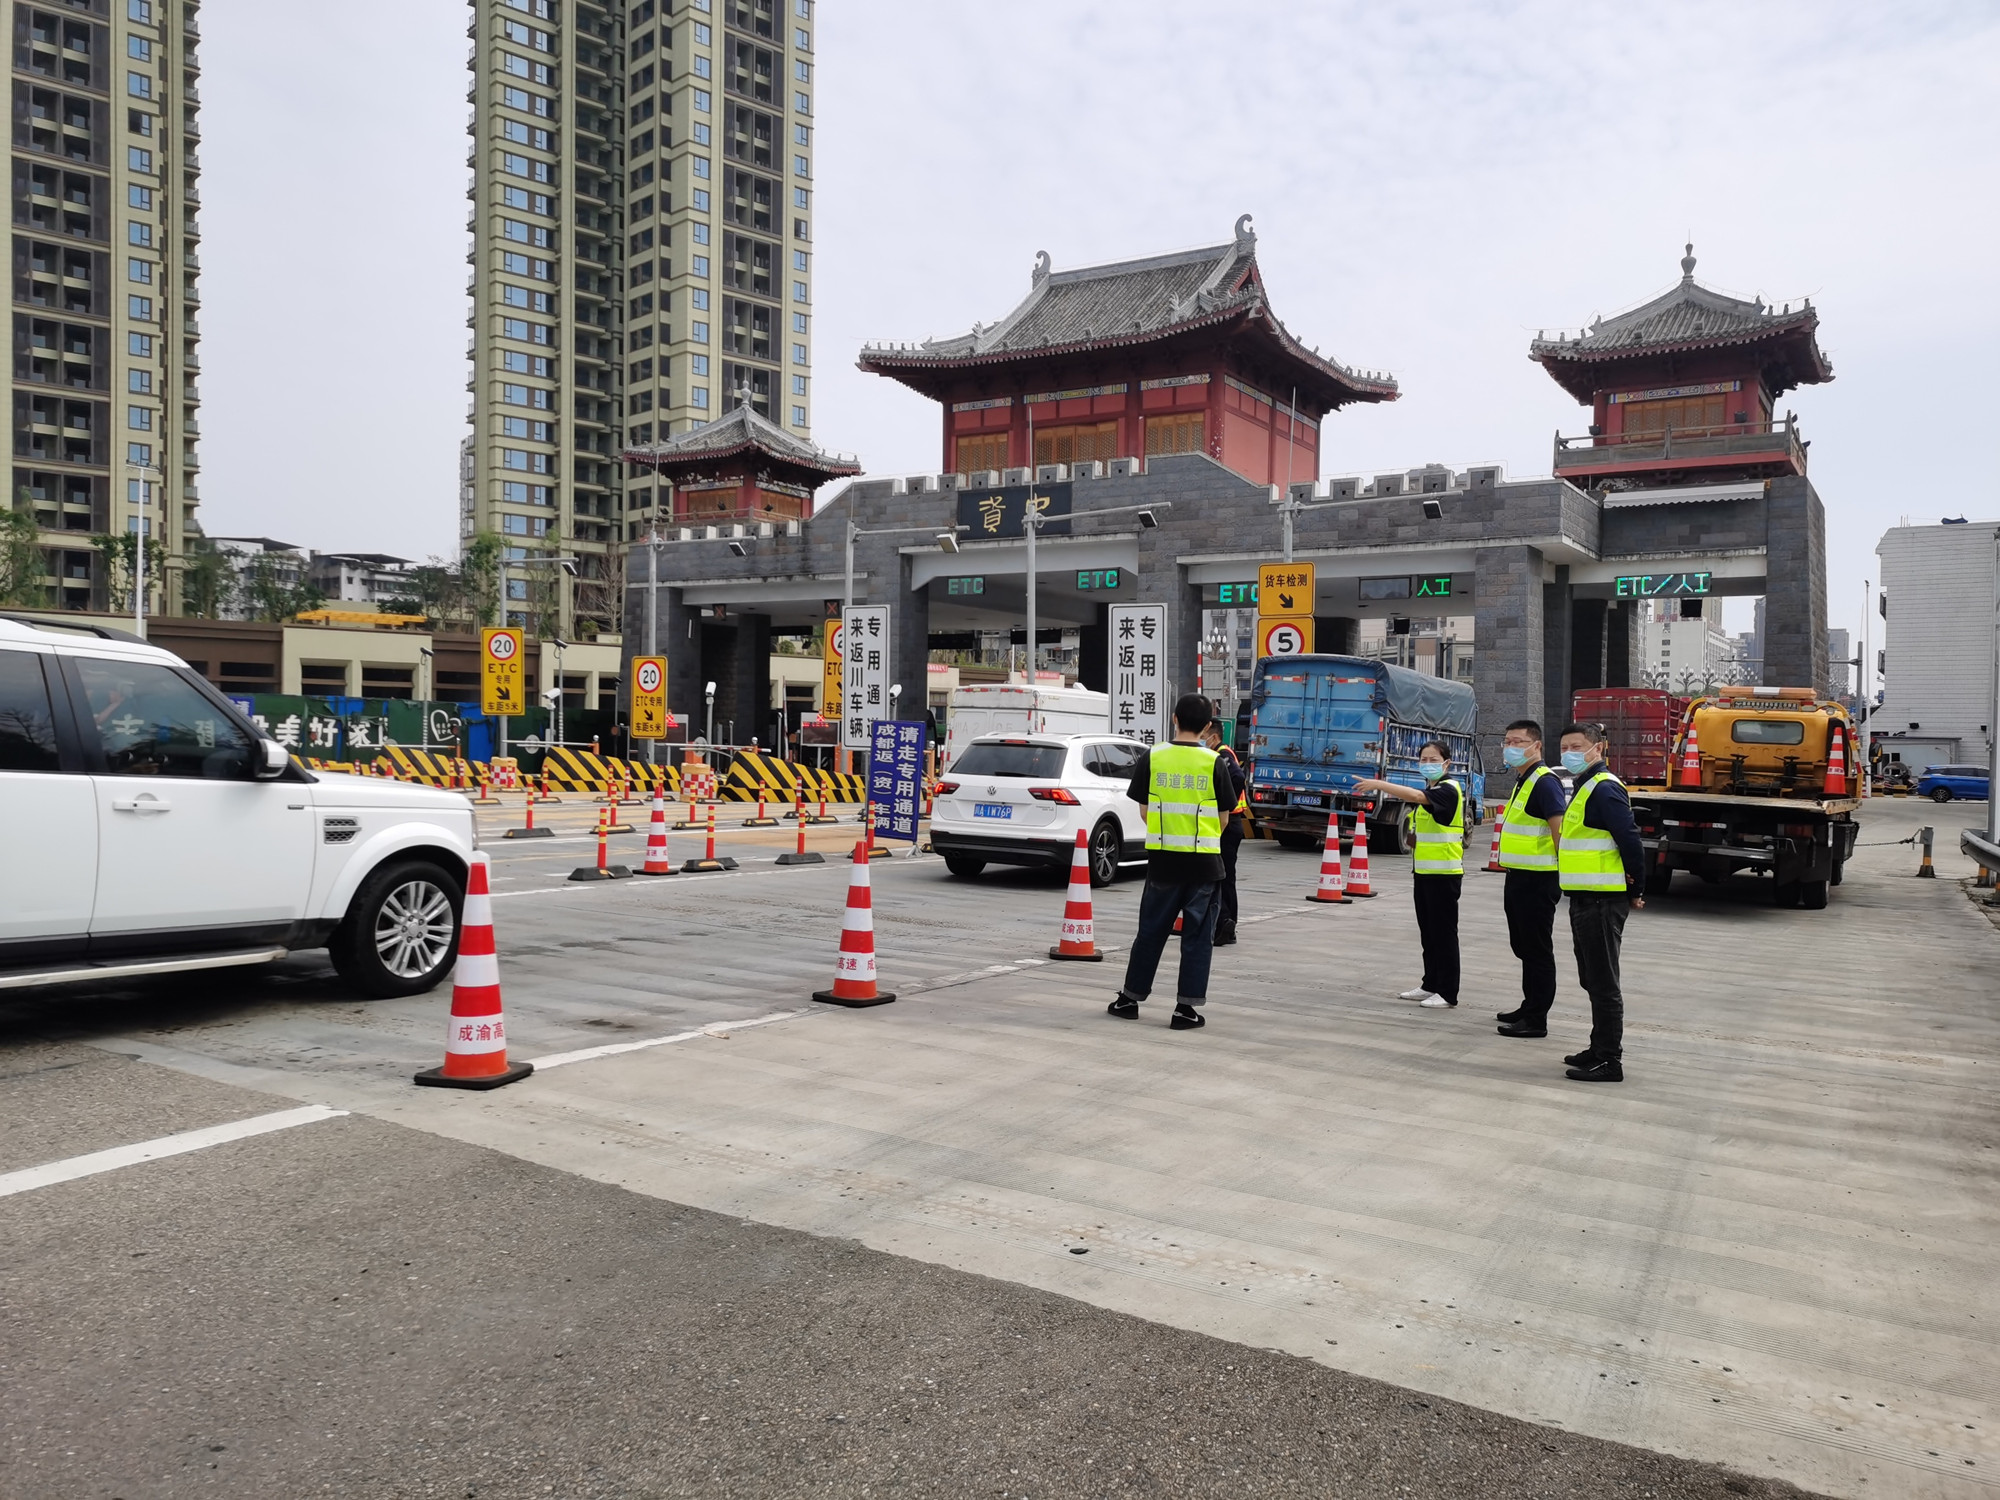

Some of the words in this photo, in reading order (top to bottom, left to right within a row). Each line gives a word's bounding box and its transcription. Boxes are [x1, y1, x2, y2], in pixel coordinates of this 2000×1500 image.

[948, 577, 984, 595] ETC
[1077, 570, 1118, 589] ETC
[1265, 573, 1308, 588] 货车检测
[1416, 578, 1450, 596] 人工
[494, 639, 512, 653] 20
[1278, 632, 1294, 653] 5
[488, 663, 518, 674] ETC
[495, 675, 511, 684] 专用
[643, 670, 657, 684] 20
[850, 616, 864, 738] 来返川车辆
[487, 702, 519, 711] 车距5米
[635, 722, 662, 733] 车距5米
[892, 726, 919, 834] 请走专用通道
[1156, 773, 1208, 791] 蜀道集团
